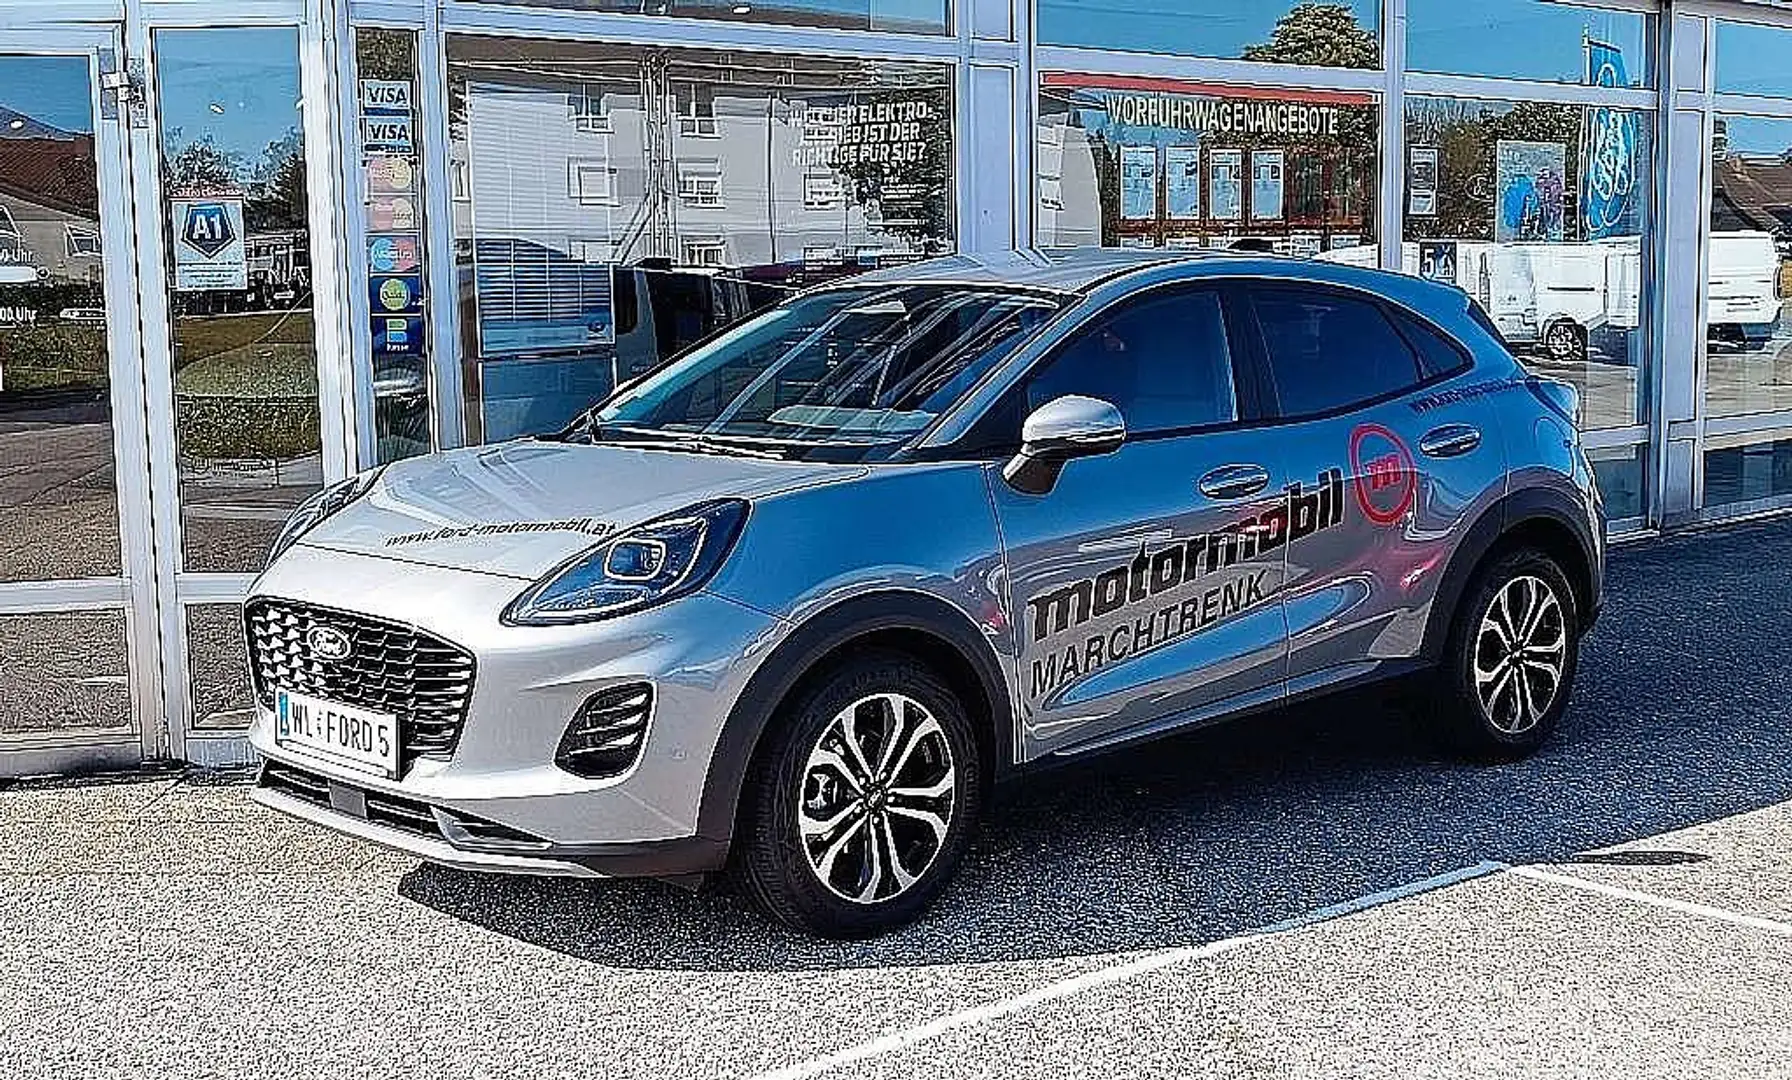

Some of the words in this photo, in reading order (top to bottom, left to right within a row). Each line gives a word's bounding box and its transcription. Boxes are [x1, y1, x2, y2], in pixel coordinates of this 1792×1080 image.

[367, 87, 408, 104] VISA
[369, 124, 409, 141] VISA
[890, 122, 920, 141] DER
[193, 214, 222, 239] A1
[12, 248, 32, 262] Uhr
[15, 306, 37, 321] Uhr
[384, 518, 617, 547] www.ford-motormobil.at
[1028, 468, 1344, 642] motormobil
[1031, 570, 1267, 699] MARCHTRENK
[291, 702, 313, 738] WL
[327, 711, 373, 752] FORD
[378, 725, 389, 757] 5
